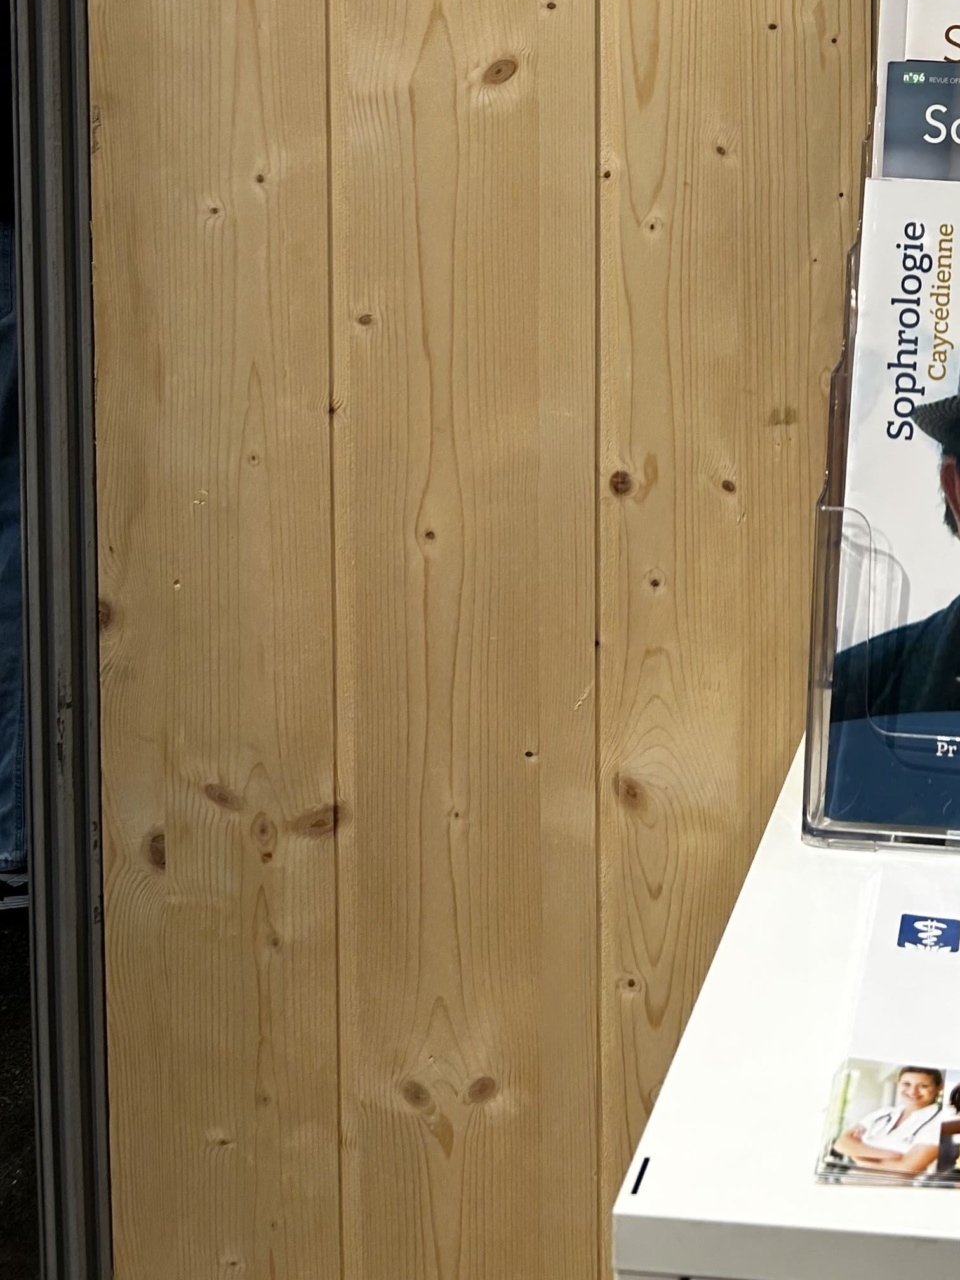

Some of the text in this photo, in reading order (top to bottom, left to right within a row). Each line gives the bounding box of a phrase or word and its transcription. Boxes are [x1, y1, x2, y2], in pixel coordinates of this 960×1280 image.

[903, 73, 925, 83] n°96
[887, 222, 932, 440] Sophrologie
[928, 224, 954, 381] Caycédienne
[936, 741, 957, 757] Pr
